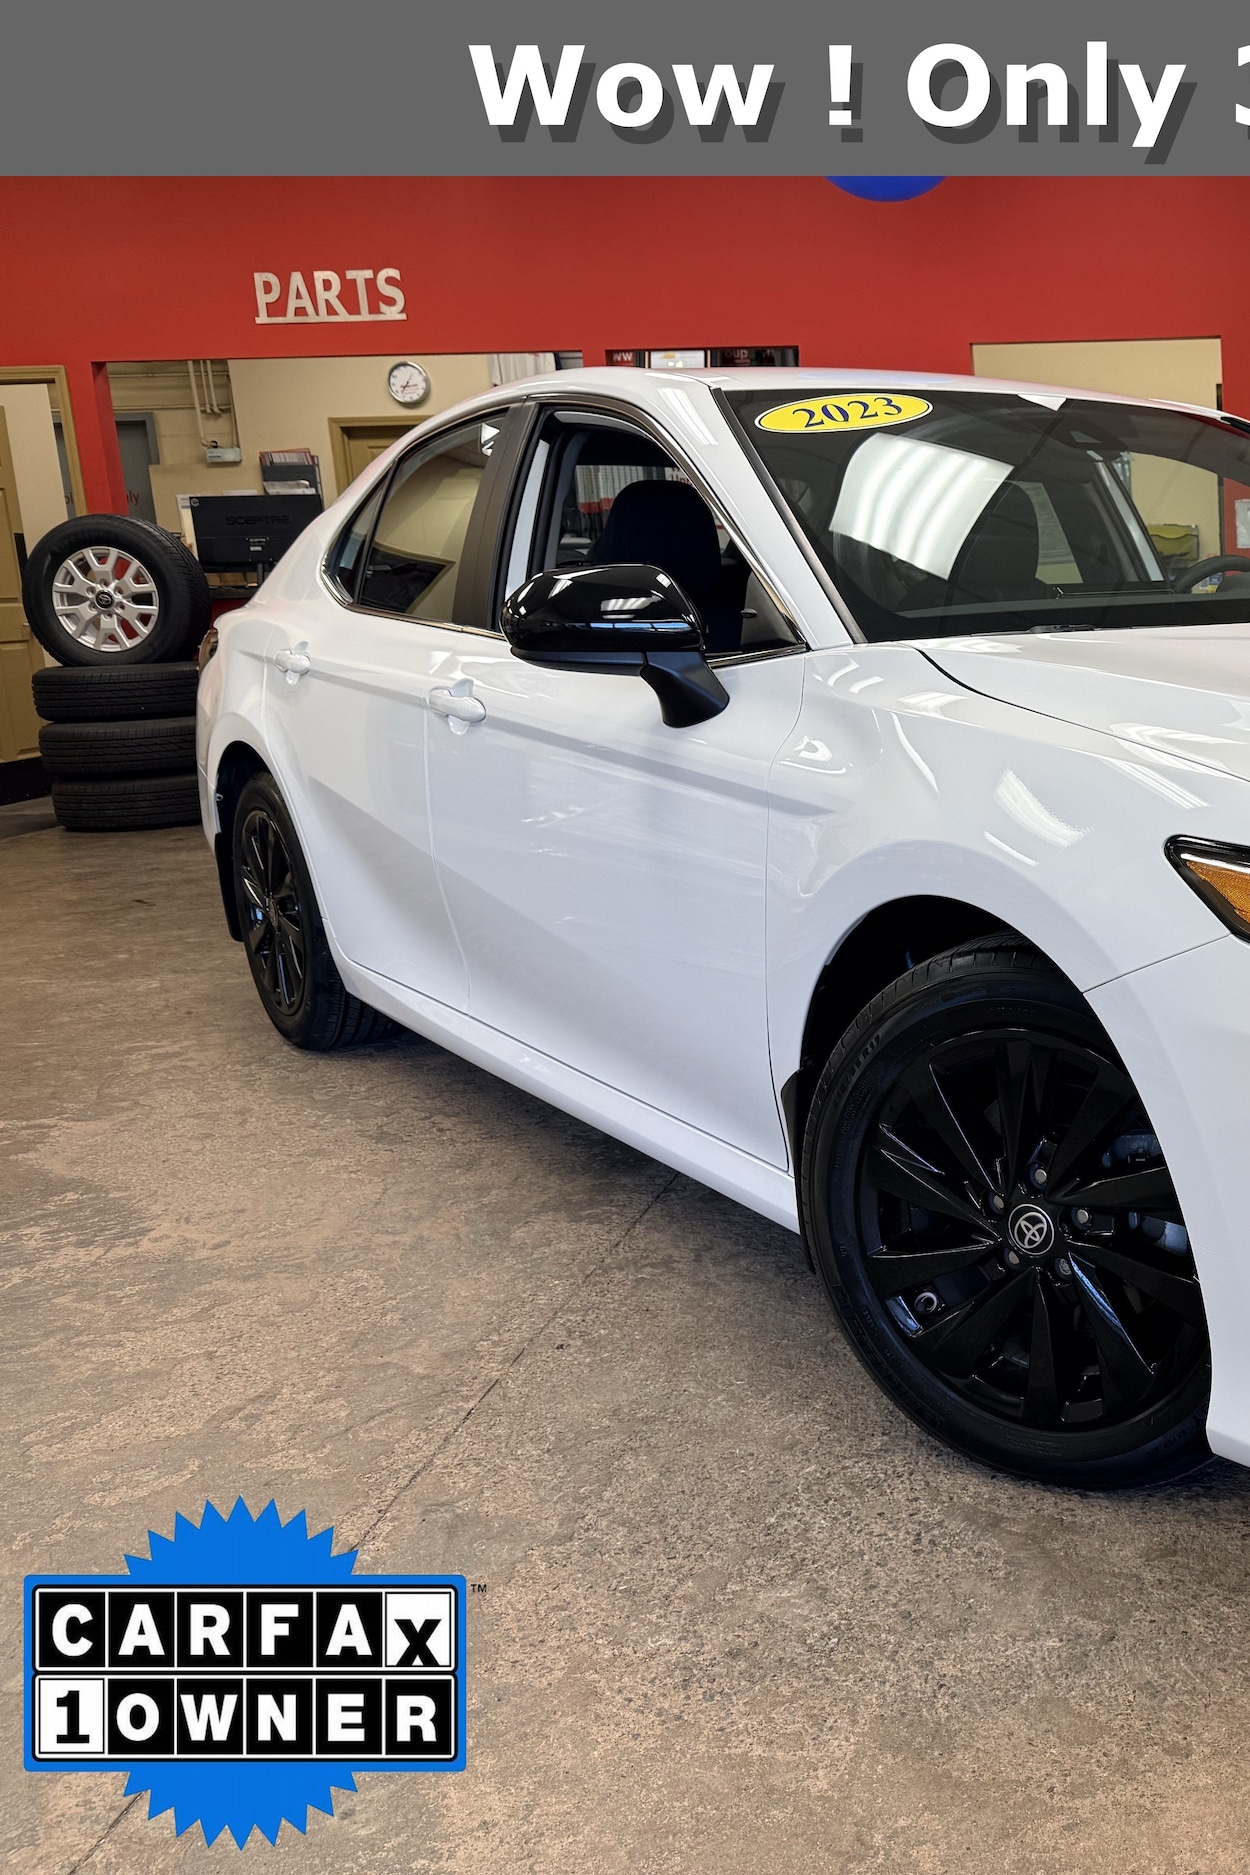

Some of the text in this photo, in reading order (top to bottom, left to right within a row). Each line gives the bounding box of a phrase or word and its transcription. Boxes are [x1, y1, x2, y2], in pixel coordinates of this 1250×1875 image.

[253, 267, 406, 323] PARTS
[792, 397, 902, 428] 2023
[226, 515, 290, 526] SCEPTRE
